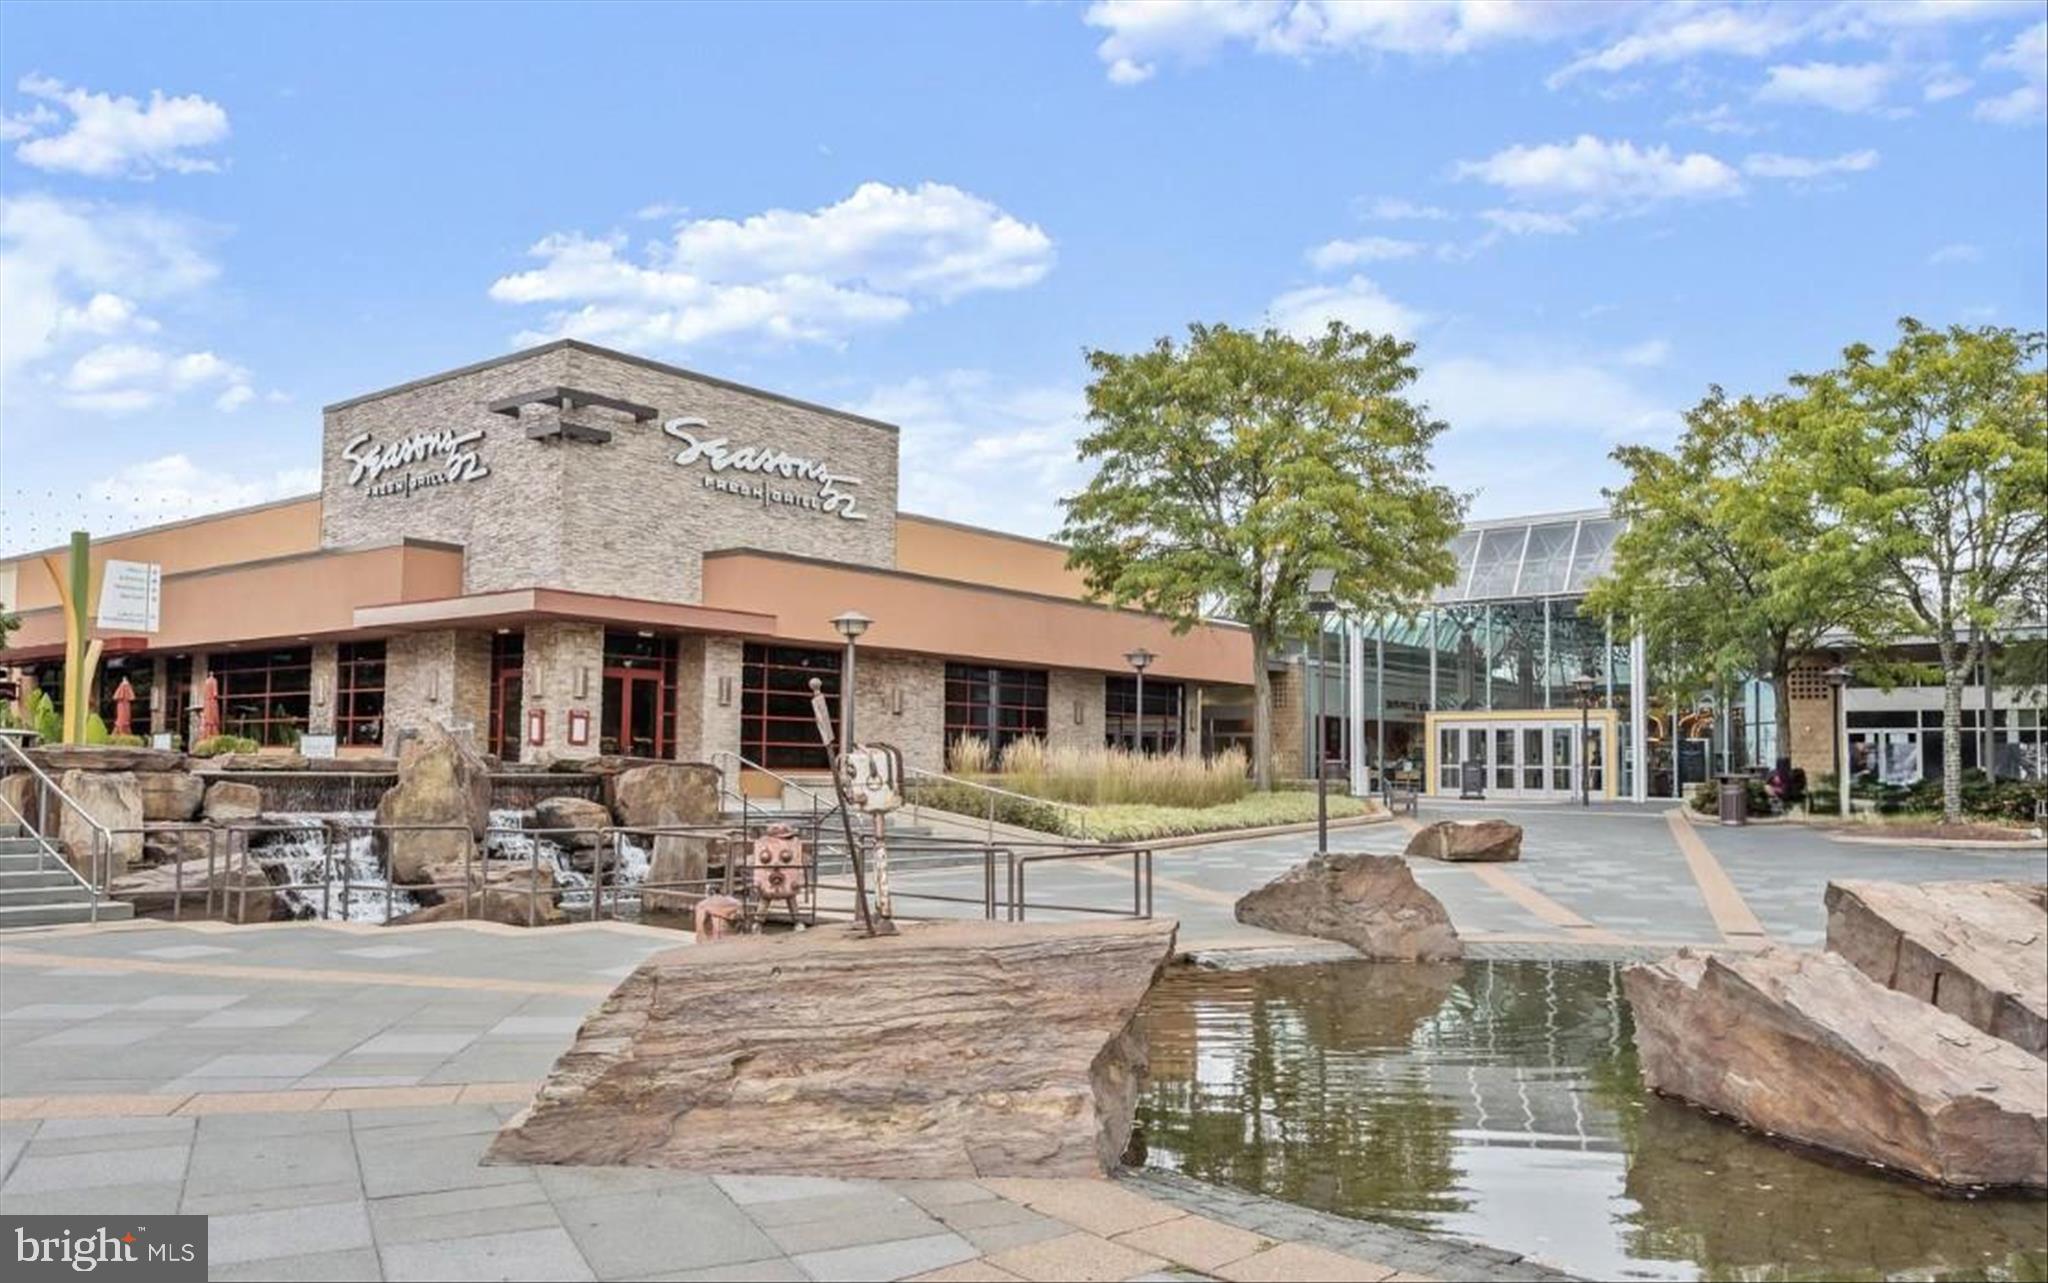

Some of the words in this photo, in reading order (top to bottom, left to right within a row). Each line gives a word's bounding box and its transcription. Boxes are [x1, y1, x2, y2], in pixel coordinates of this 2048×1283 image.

[342, 429, 486, 486] Seasons
[662, 416, 862, 483] Seasons
[817, 477, 868, 520] 52
